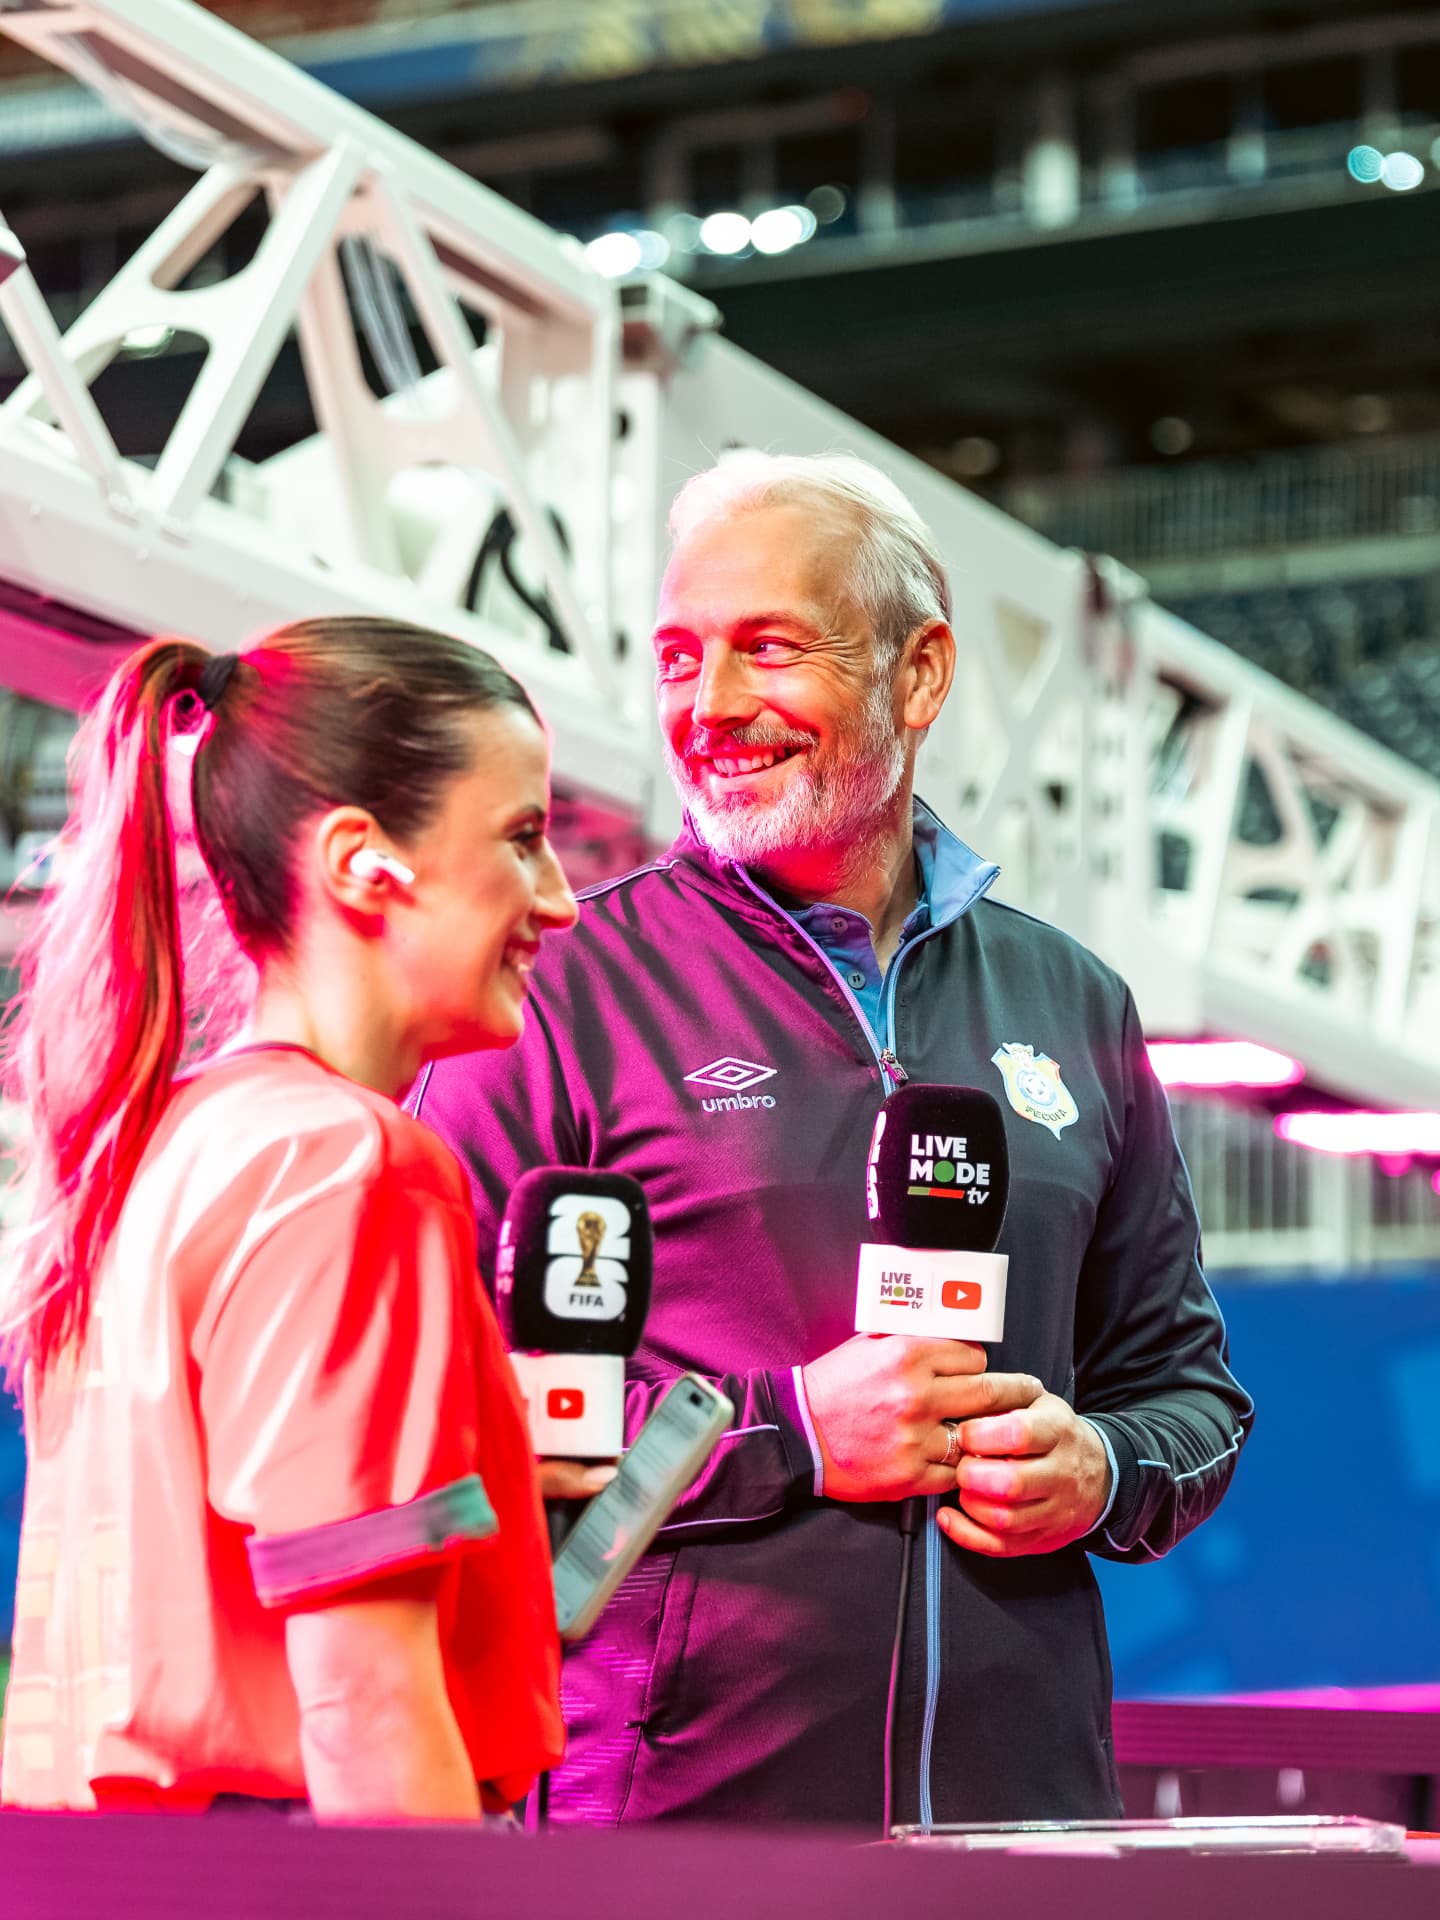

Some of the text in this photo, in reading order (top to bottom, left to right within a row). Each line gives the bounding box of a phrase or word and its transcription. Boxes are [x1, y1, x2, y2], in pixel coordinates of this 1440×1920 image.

[702, 1093, 776, 1112] umbro
[911, 1134, 967, 1159] LIVE
[909, 1159, 990, 1186] MODE
[966, 1187, 990, 1205] tv
[881, 1271, 912, 1285] LIVE
[880, 1284, 924, 1299] MODE
[569, 1293, 605, 1308] FIFA
[911, 1300, 923, 1309] tv
